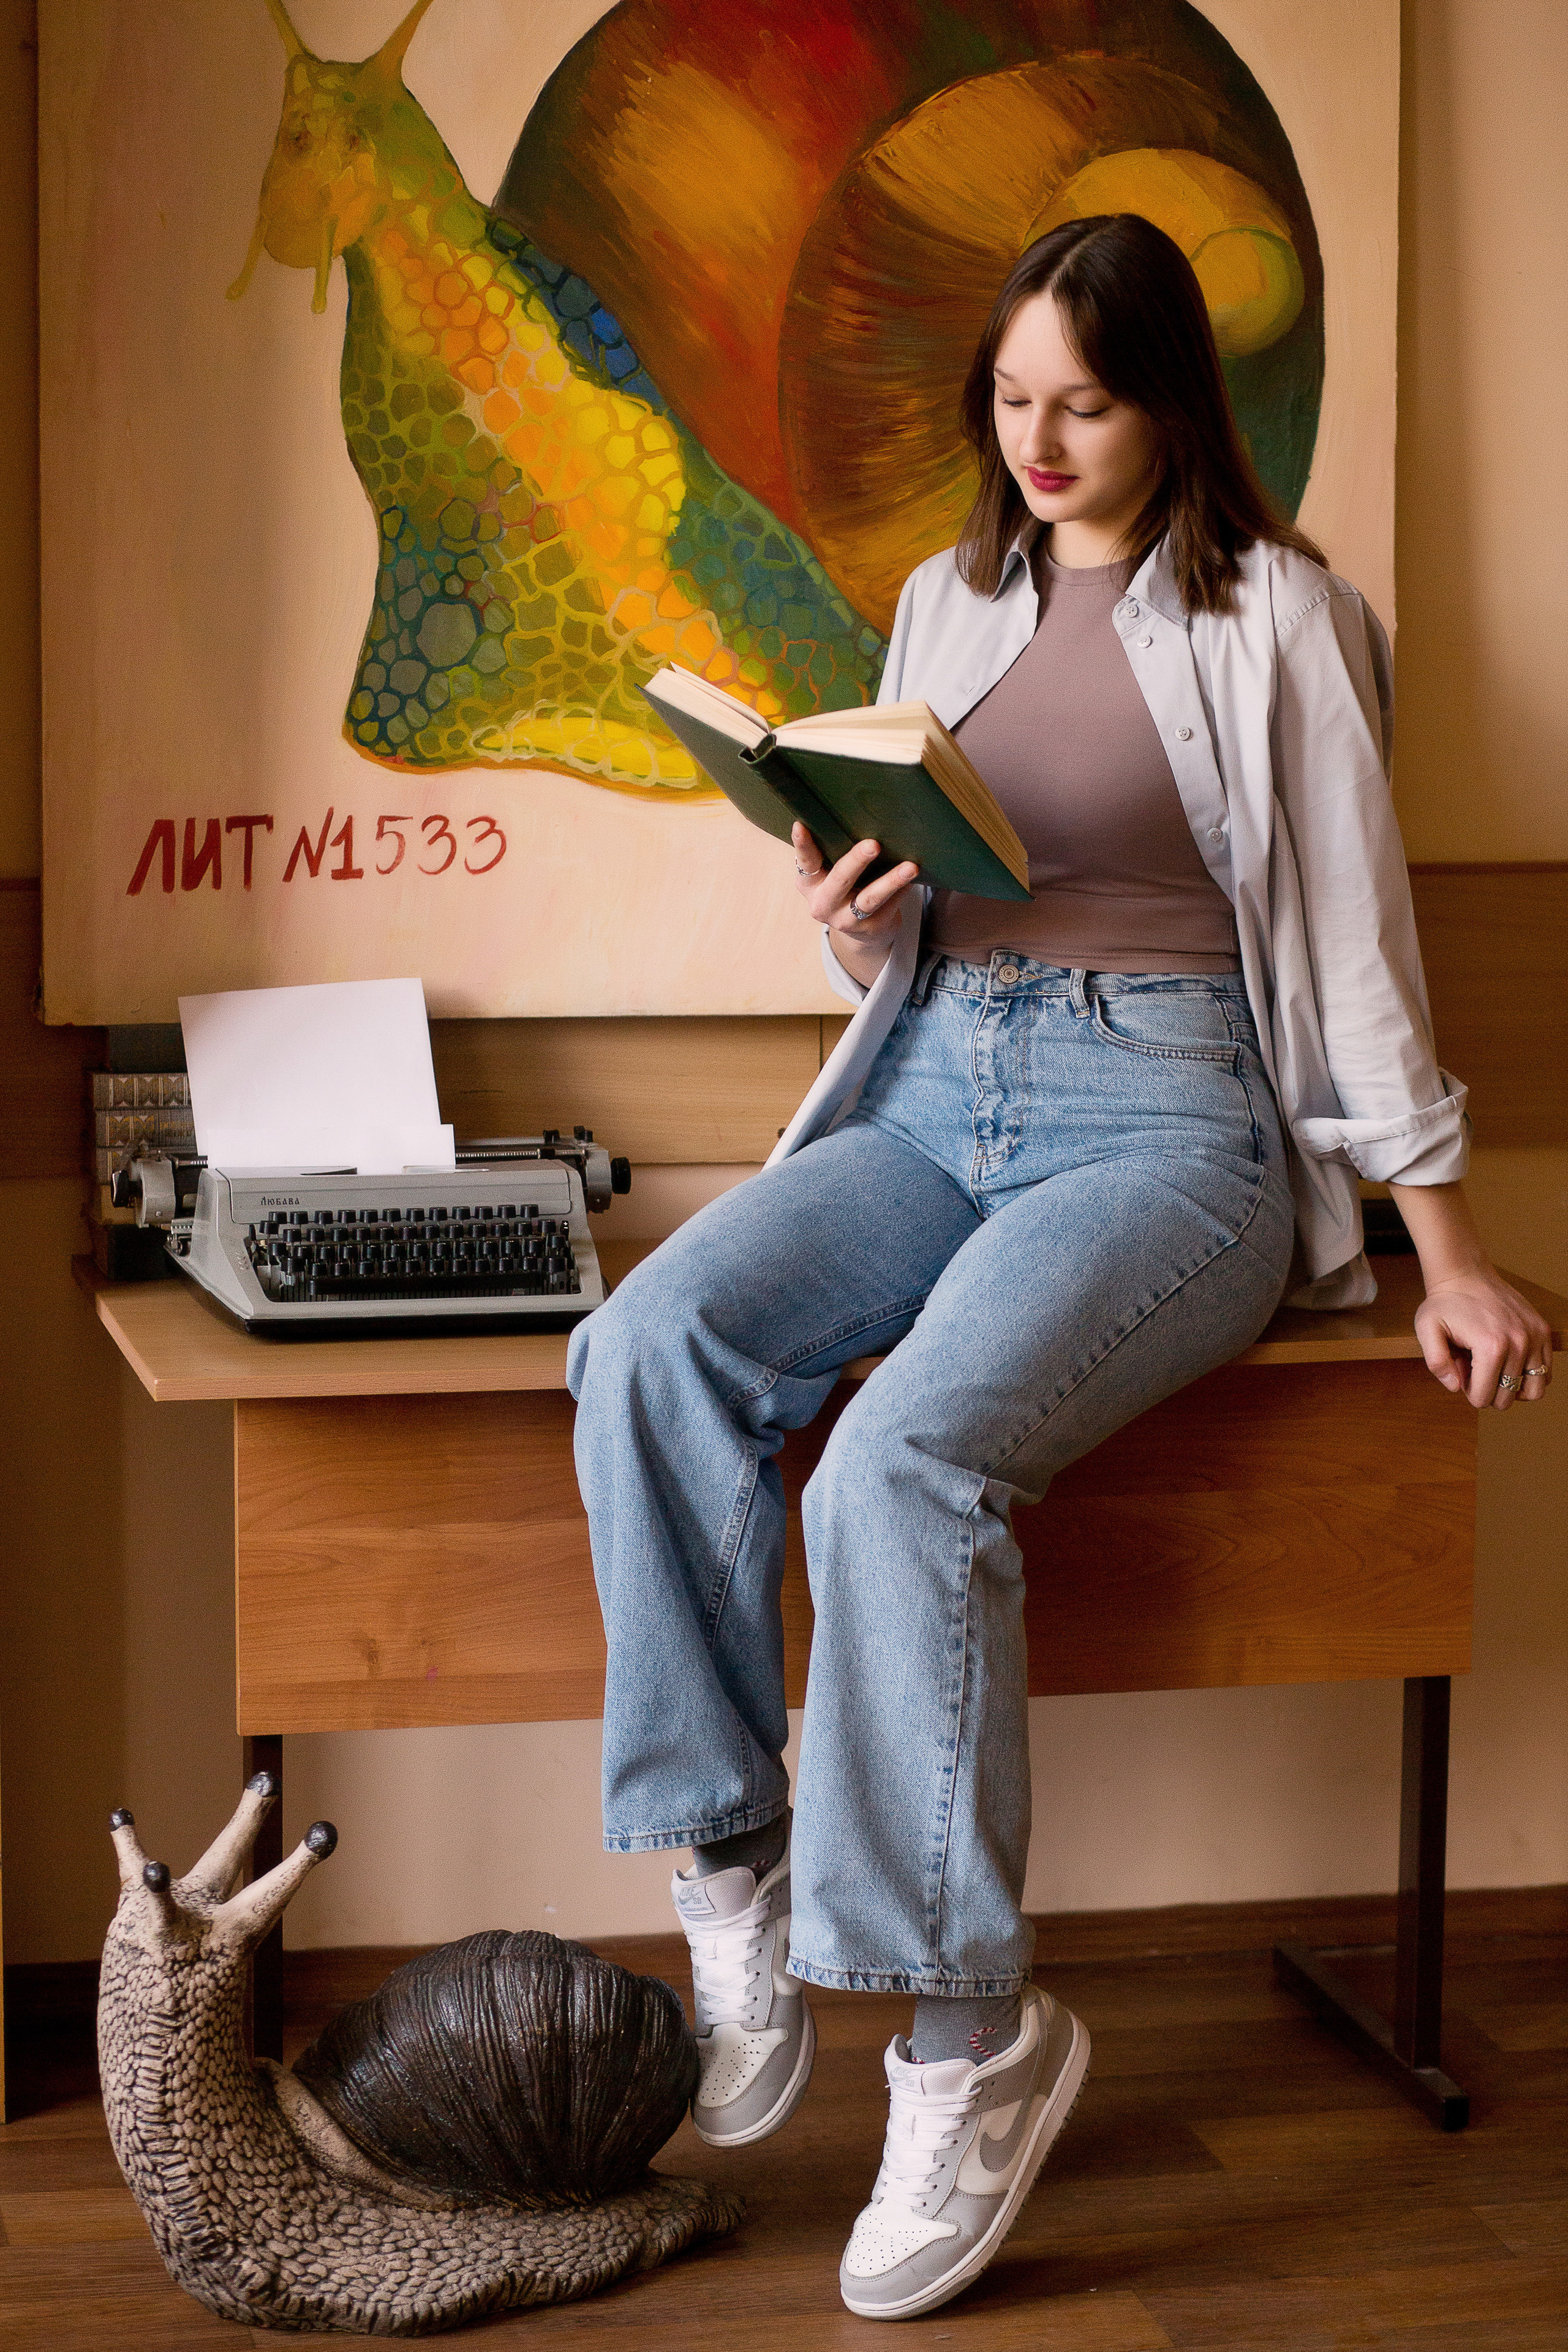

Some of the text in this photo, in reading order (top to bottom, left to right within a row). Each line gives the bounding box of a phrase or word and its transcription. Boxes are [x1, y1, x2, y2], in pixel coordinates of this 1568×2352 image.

[126, 814, 274, 896] ЛИТ
[693, 1896, 703, 1905] SB
[905, 2079, 915, 2087] SB
